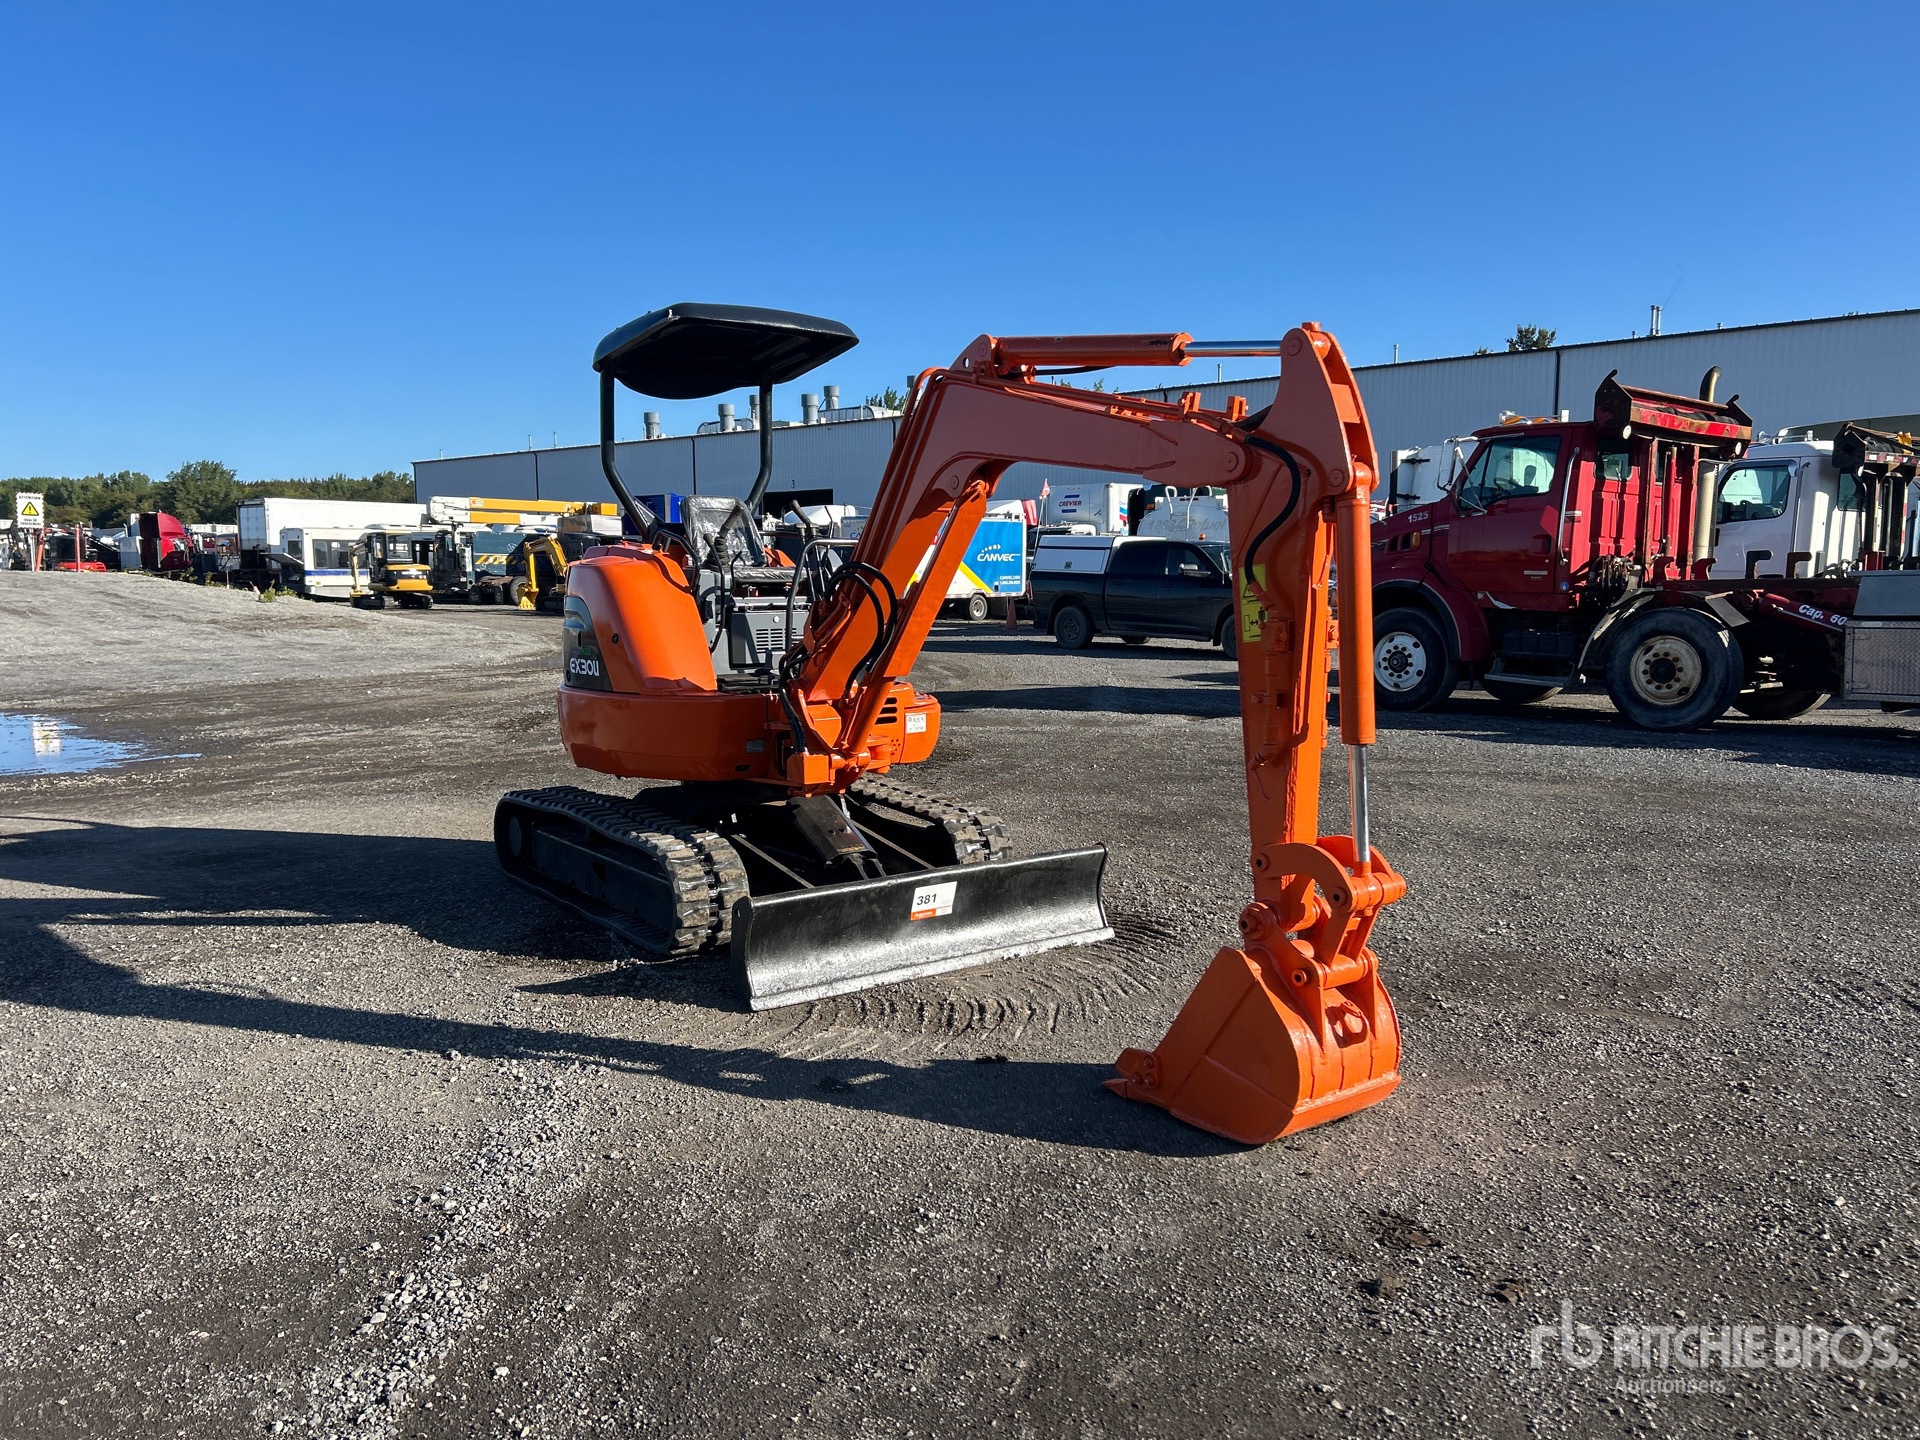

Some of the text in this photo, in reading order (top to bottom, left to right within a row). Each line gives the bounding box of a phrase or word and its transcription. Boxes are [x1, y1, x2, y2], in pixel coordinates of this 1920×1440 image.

[790, 479, 796, 489] 3
[1407, 511, 1429, 523] 1525
[976, 553, 1020, 562] CANVEC
[1798, 604, 1824, 620] Cap.
[916, 893, 937, 906] 381
